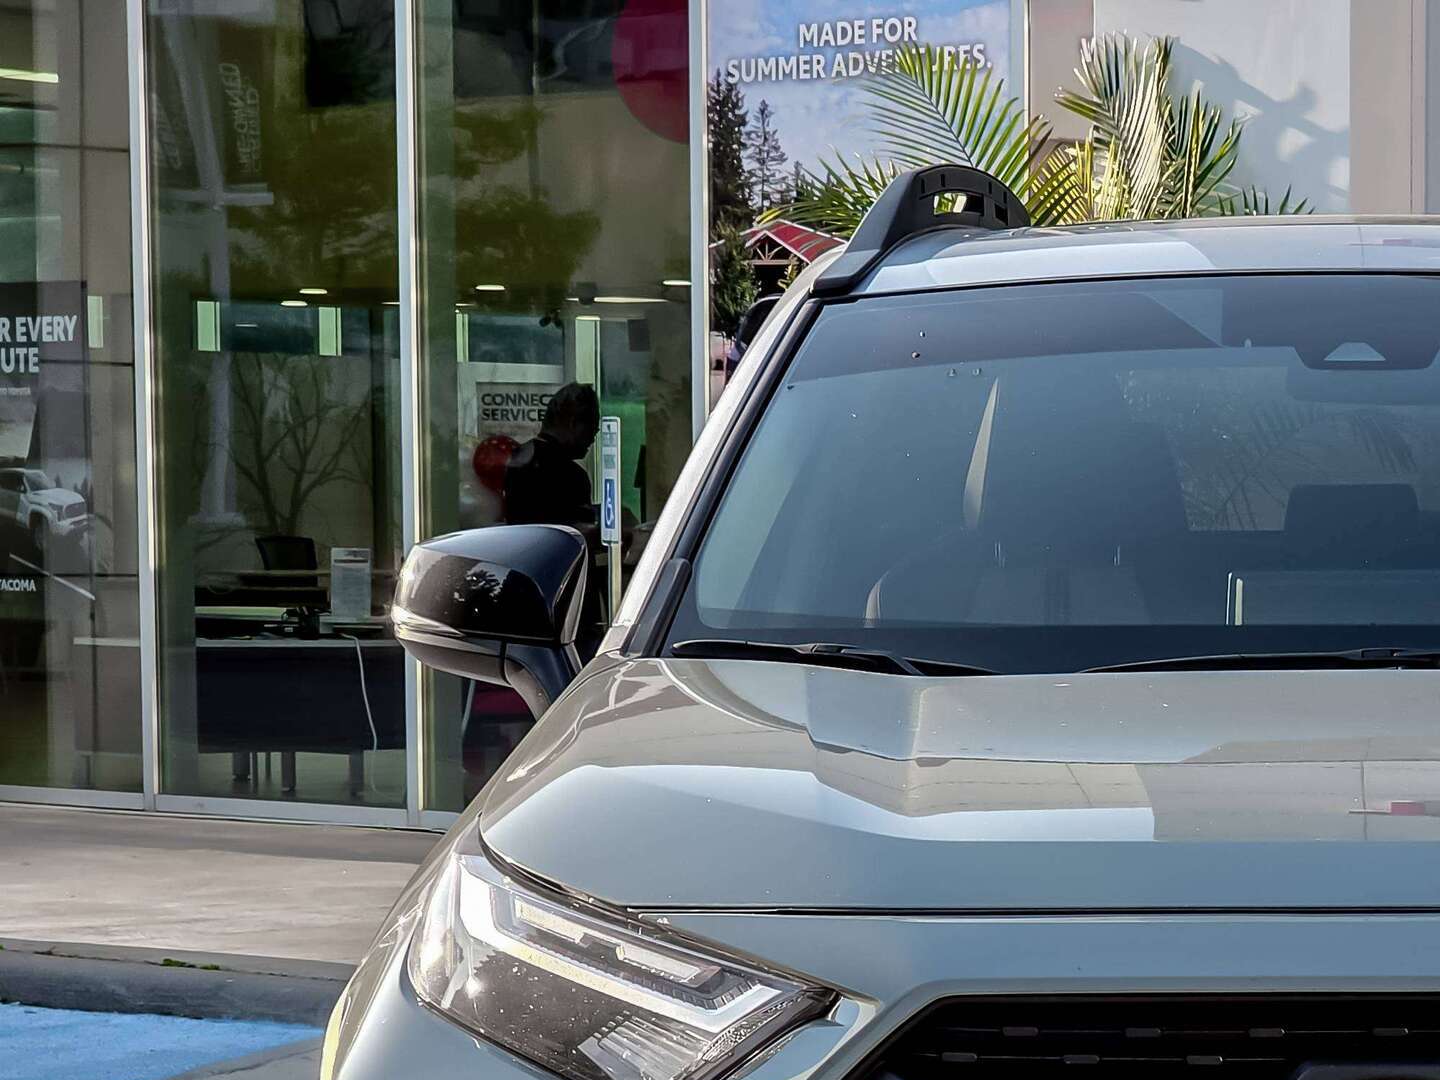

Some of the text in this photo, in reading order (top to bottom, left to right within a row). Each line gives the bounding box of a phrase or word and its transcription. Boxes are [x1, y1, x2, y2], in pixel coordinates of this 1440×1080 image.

[799, 15, 918, 48] MADE FOR
[727, 43, 993, 83] SUMMER ADVEURES.
[15, 315, 78, 342] EVERY
[0, 578, 37, 592] ACOMA
